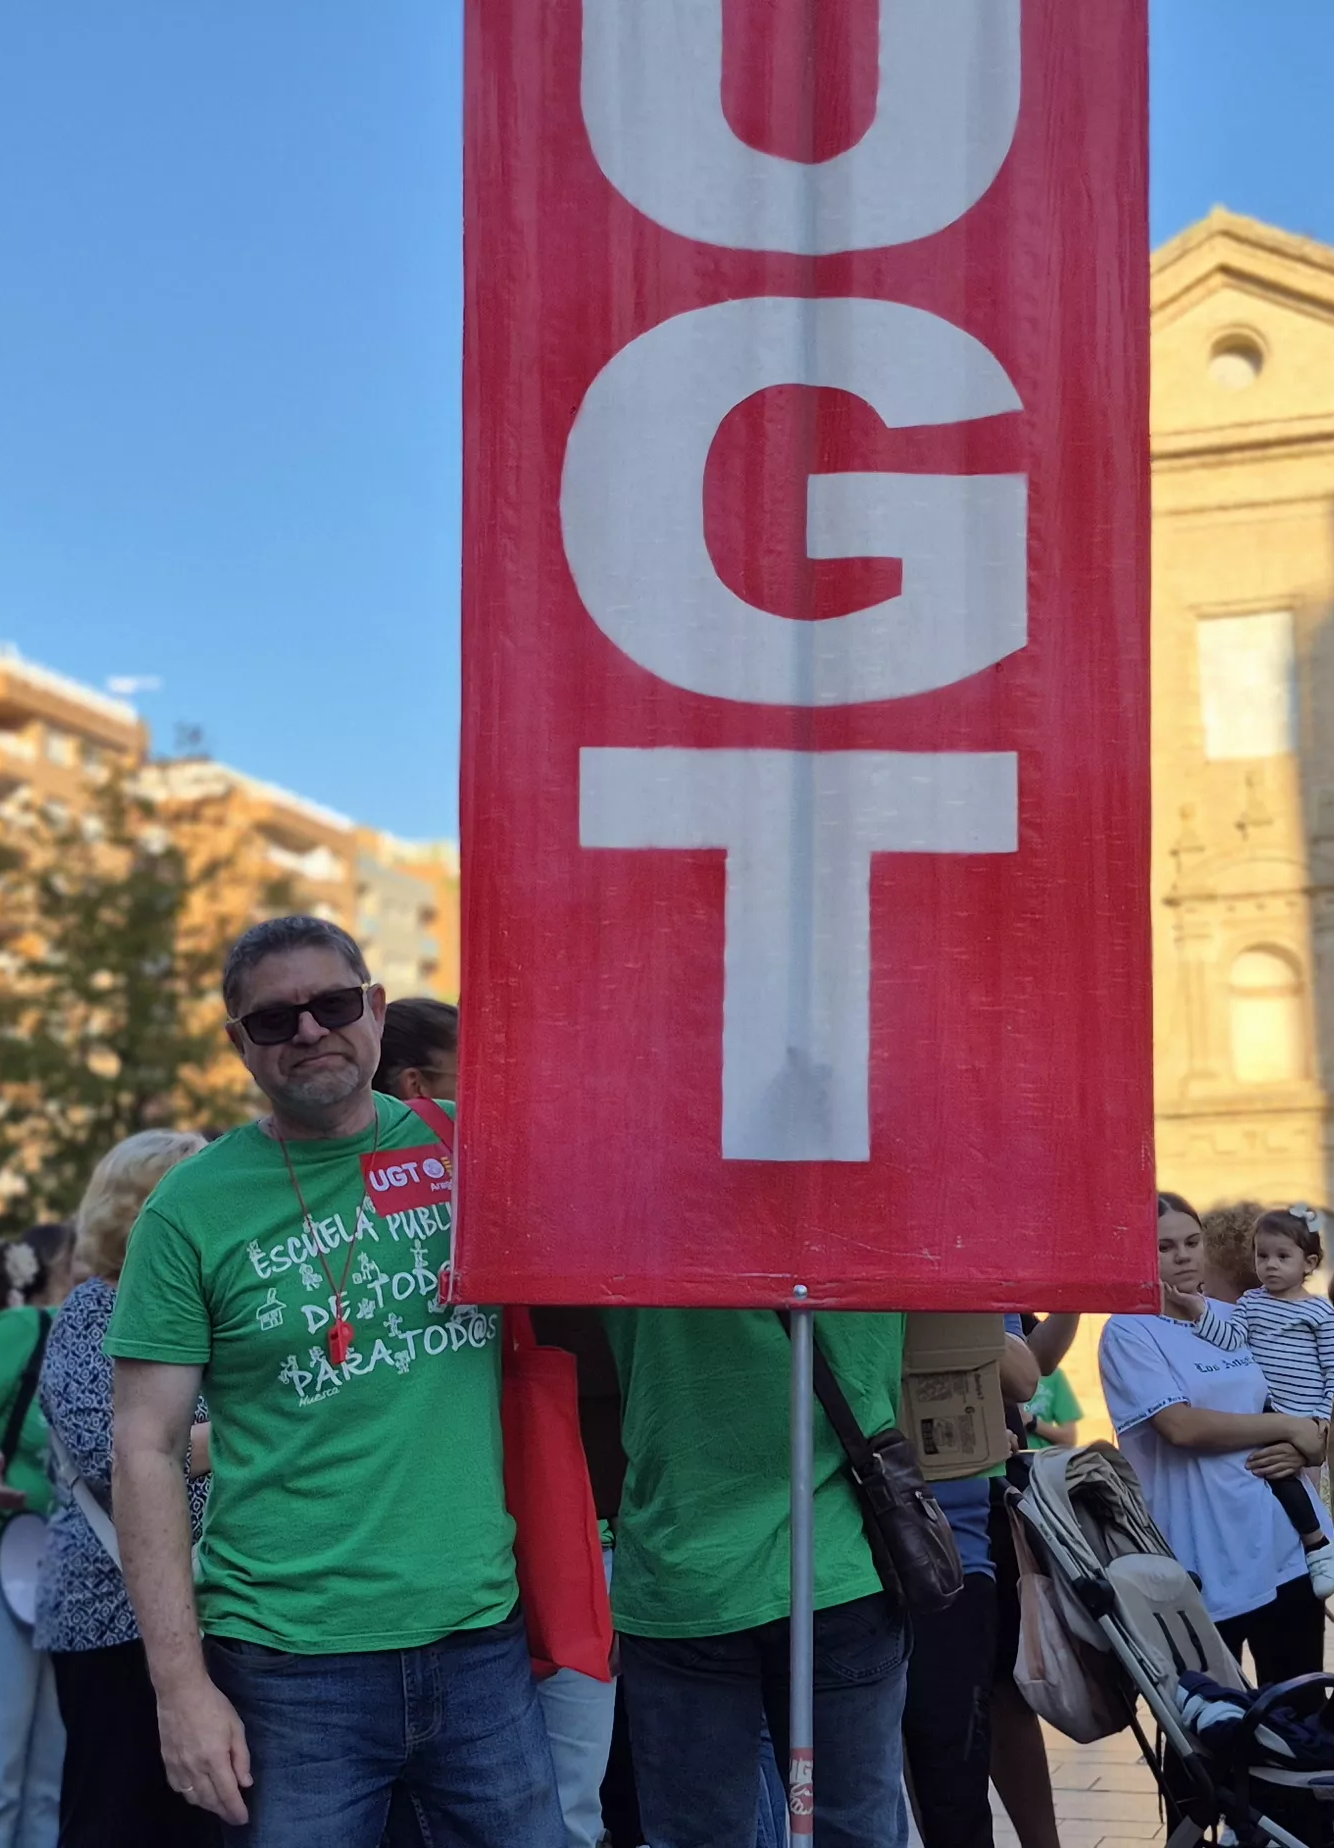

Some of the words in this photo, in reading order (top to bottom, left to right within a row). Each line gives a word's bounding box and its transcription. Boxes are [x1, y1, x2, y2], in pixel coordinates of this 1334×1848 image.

[559, 0, 1028, 1162] UGT
[369, 1161, 420, 1192] UGT
[251, 1206, 380, 1279] ESCUELA
[300, 1291, 351, 1335] DE
[367, 1264, 441, 1308] TOD
[290, 1338, 395, 1397] PARA
[398, 1312, 498, 1360] TOD@S
[298, 1386, 341, 1408] Huesca
